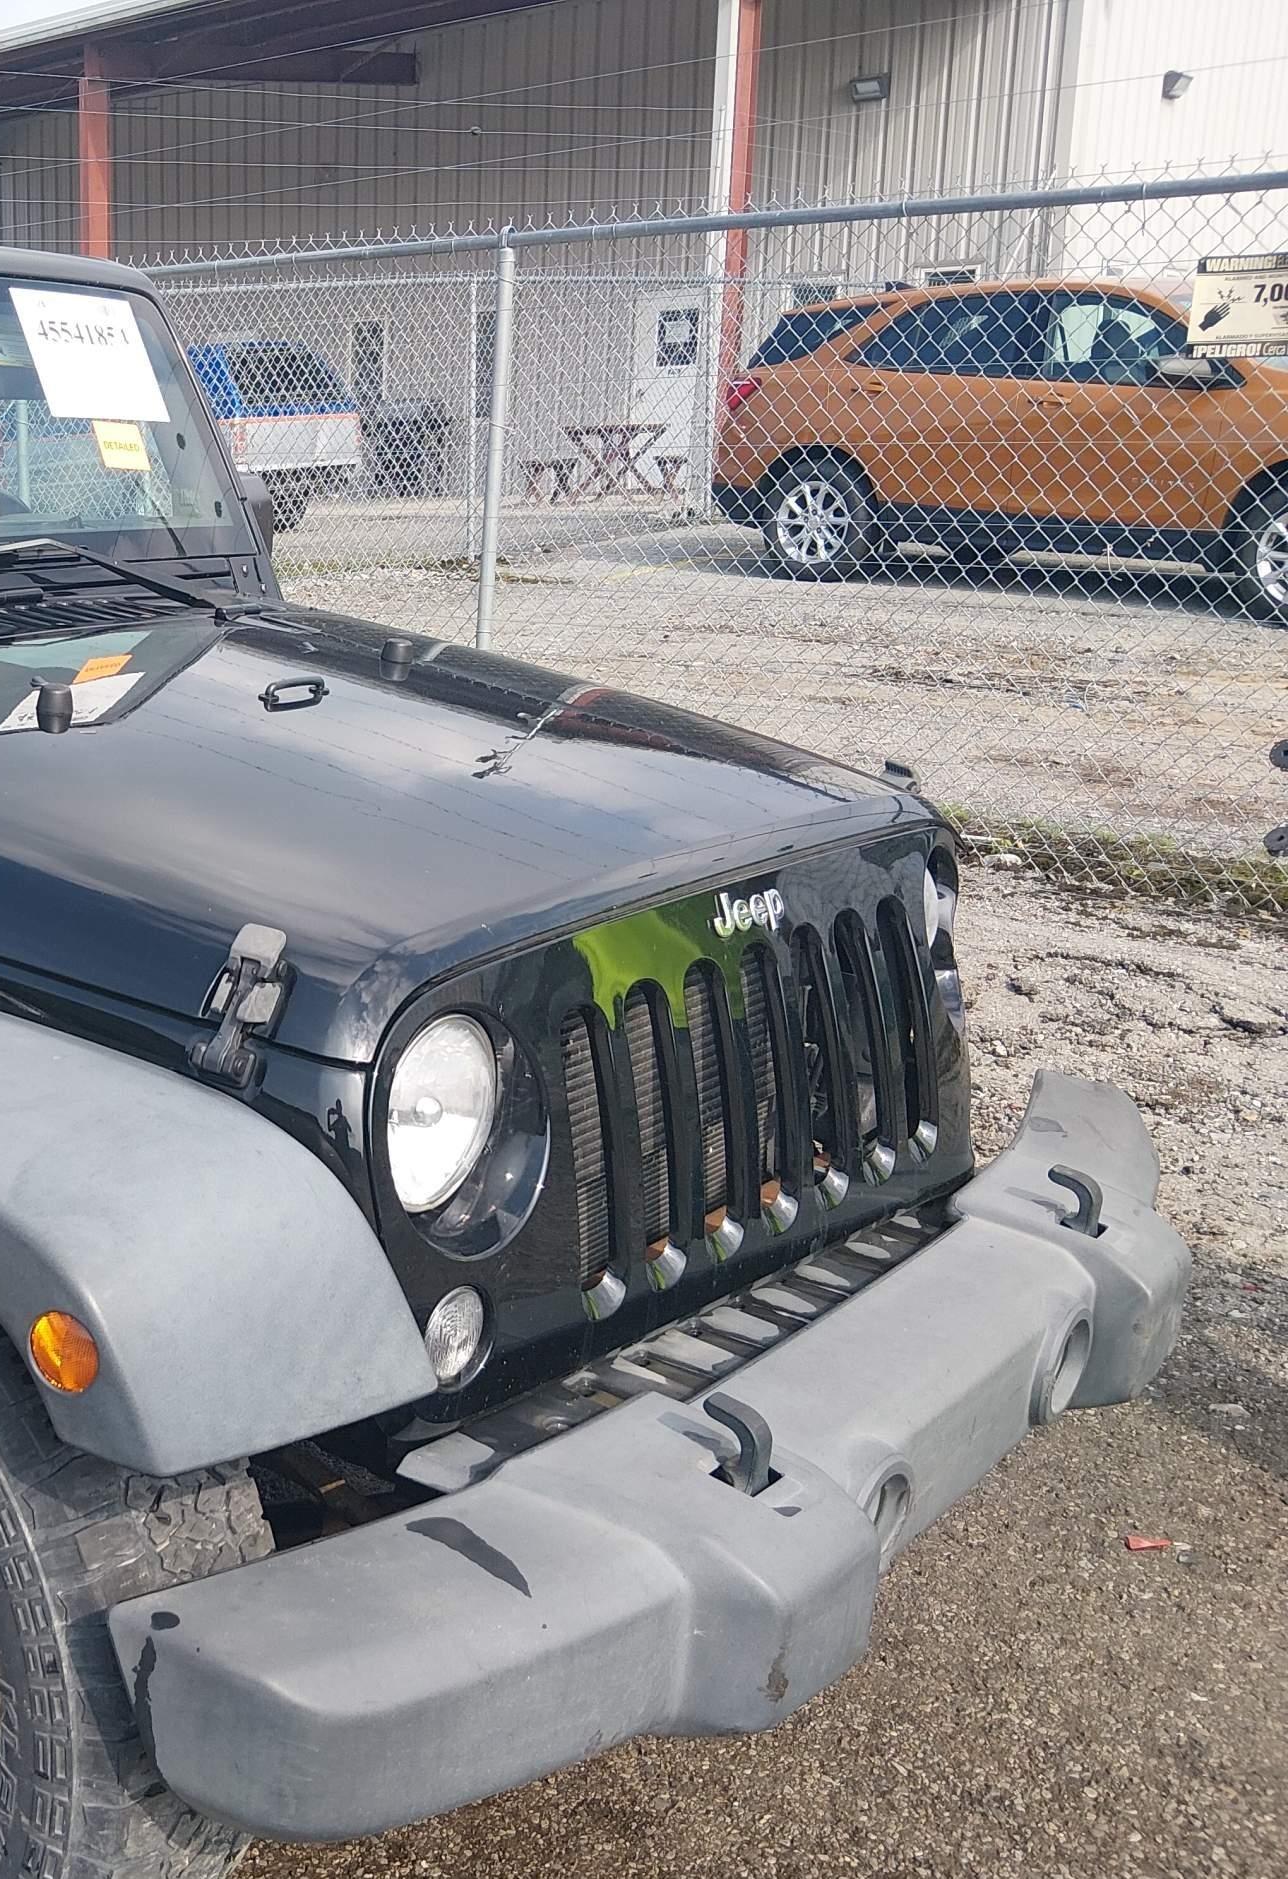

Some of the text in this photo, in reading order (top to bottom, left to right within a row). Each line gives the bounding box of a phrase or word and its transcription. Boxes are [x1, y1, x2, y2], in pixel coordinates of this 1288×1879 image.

[1206, 256, 1277, 272] WARNING!
[1263, 343, 1287, 356] Cerca
[714, 888, 785, 938] Jeep
